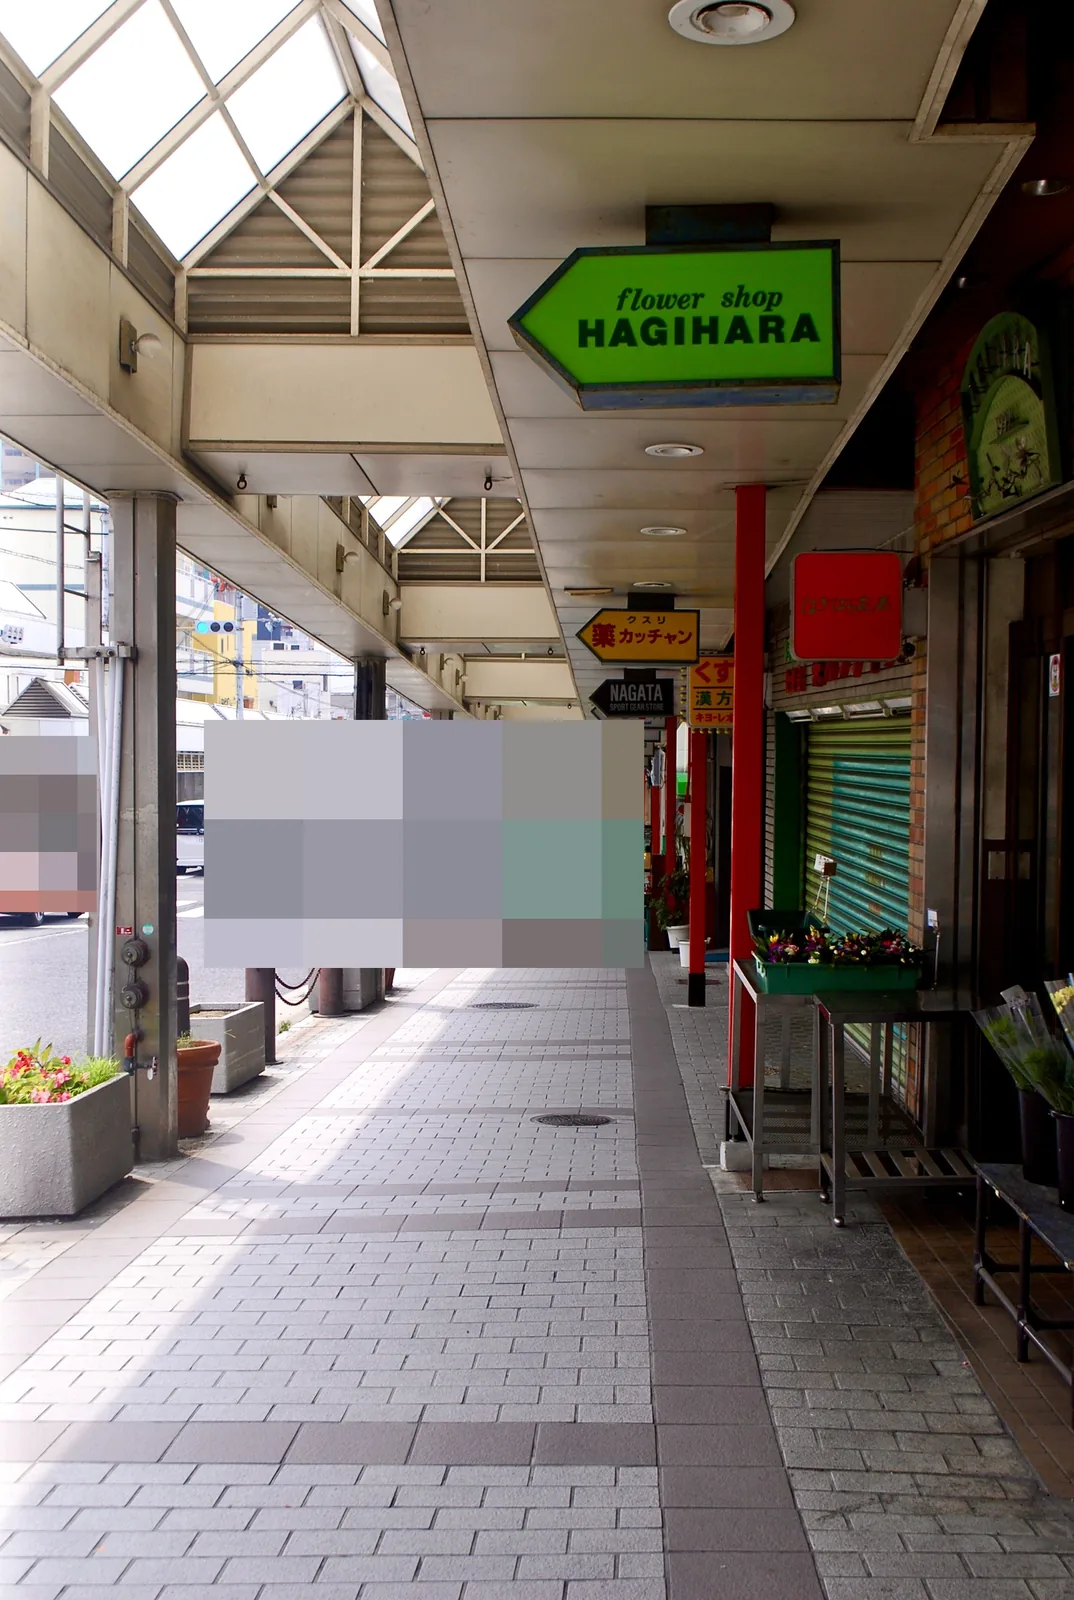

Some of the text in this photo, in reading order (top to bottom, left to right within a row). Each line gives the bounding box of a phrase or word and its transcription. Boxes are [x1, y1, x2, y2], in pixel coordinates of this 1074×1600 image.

[616, 284, 783, 312] flower shop
[577, 312, 821, 348] HAGIHARA
[627, 616, 666, 625] クスリ
[610, 684, 663, 702] NAGATA
[695, 690, 733, 706] 漢方
[609, 703, 664, 712] SPORT GEAR STORE
